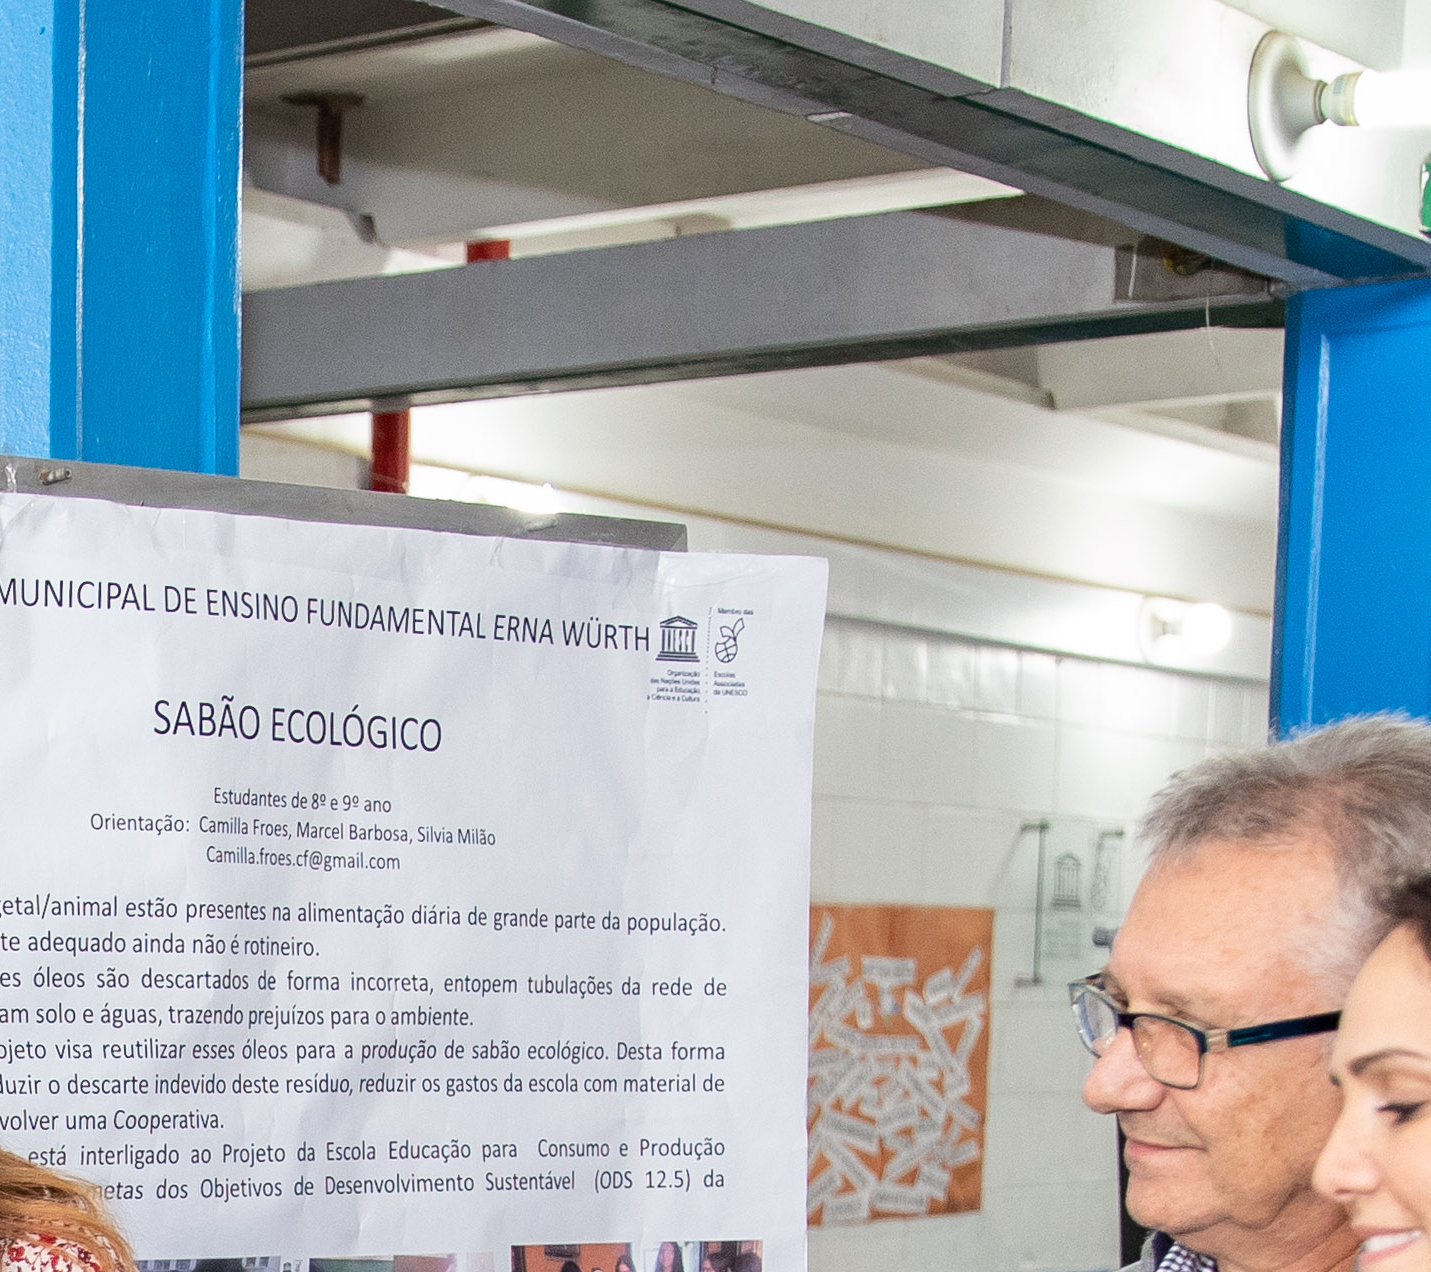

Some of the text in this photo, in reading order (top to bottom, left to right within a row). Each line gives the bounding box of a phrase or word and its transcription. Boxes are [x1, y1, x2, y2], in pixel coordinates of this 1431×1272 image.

[164, 585, 198, 615] DE
[206, 588, 299, 623] ENSINO
[306, 597, 487, 640] FUNDAMENTAL
[493, 613, 555, 646] ERNA
[561, 616, 650, 652] WÜRTH
[153, 694, 442, 753] SABÃO ECOLÓGICO
[213, 786, 288, 809] Estudantes
[290, 791, 308, 810] de
[329, 797, 339, 812] e
[363, 799, 392, 814] ano
[90, 812, 496, 846] Orientação: Camilla Froes, Marcel Barbosa, Silvia Milão
[206, 845, 401, 873] Camilla.froes.cf@gmail.com
[125, 896, 178, 919] estão
[185, 901, 267, 924] presentes
[272, 905, 291, 922] na
[297, 901, 405, 929] alimentação
[411, 904, 461, 926] diária
[467, 905, 488, 927] de
[493, 907, 549, 932] grande
[554, 912, 596, 933] parte
[601, 910, 621, 931] da
[627, 911, 726, 937] população.
[27, 930, 127, 958] adequado
[131, 932, 185, 954] ainda
[192, 933, 227, 955] não
[230, 933, 240, 956] é
[244, 935, 320, 957] rotineiro.
[32, 965, 86, 989] óleos
[96, 966, 130, 989] são
[140, 967, 250, 991] descartados
[257, 969, 277, 991] de
[286, 969, 340, 992] forma
[350, 971, 434, 996] incorreta,
[443, 975, 518, 998] entopem
[527, 973, 613, 1000] tubulações
[621, 975, 641, 996] da
[651, 976, 693, 997] rede
[703, 976, 727, 997] de
[35, 1001, 77, 1025] solo
[82, 1008, 94, 1024] e
[100, 1002, 163, 1029] águas,
[167, 1003, 244, 1026] trazendo
[247, 1004, 325, 1031] prejuízos
[330, 1010, 370, 1030] para
[375, 1010, 387, 1026] o
[390, 1005, 474, 1027] ambiente.
[54, 1038, 93, 1060] visa
[102, 1037, 187, 1060] reutilizar
[191, 1043, 236, 1060] esses
[241, 1038, 289, 1060] óleos
[296, 1044, 336, 1064] para
[344, 1044, 354, 1060] a
[360, 1038, 438, 1064] produção
[443, 1038, 465, 1060] de
[471, 1039, 521, 1060] sabão
[527, 1039, 609, 1065] ecológico.
[616, 1041, 663, 1061] Desta
[671, 1040, 726, 1061] forma
[47, 1079, 61, 1095] o
[67, 1072, 149, 1095] descarte
[154, 1072, 227, 1095] indevido
[231, 1073, 280, 1095] deste
[285, 1072, 354, 1097] resíduo,
[358, 1072, 417, 1094] reduzir
[421, 1077, 441, 1093] os
[445, 1075, 499, 1098] gastos
[503, 1072, 523, 1093] da
[528, 1072, 579, 1093] escola
[583, 1078, 618, 1093] com
[623, 1073, 696, 1093] material
[702, 1072, 725, 1093] de
[65, 1114, 107, 1131] uma
[113, 1108, 224, 1135] Cooperativa.
[28, 1136, 726, 1170] está interligado ao Projeto da Escola Educação para Consumo e Produção
[155, 1177, 189, 1200] dos
[200, 1177, 283, 1204] Objetivos
[293, 1175, 315, 1197] de
[324, 1172, 475, 1196] Desenvolvimento
[485, 1170, 575, 1192] Sustentável
[594, 1169, 634, 1194] (ODS
[645, 1168, 691, 1193] 12.5)
[703, 1168, 725, 1188] da
